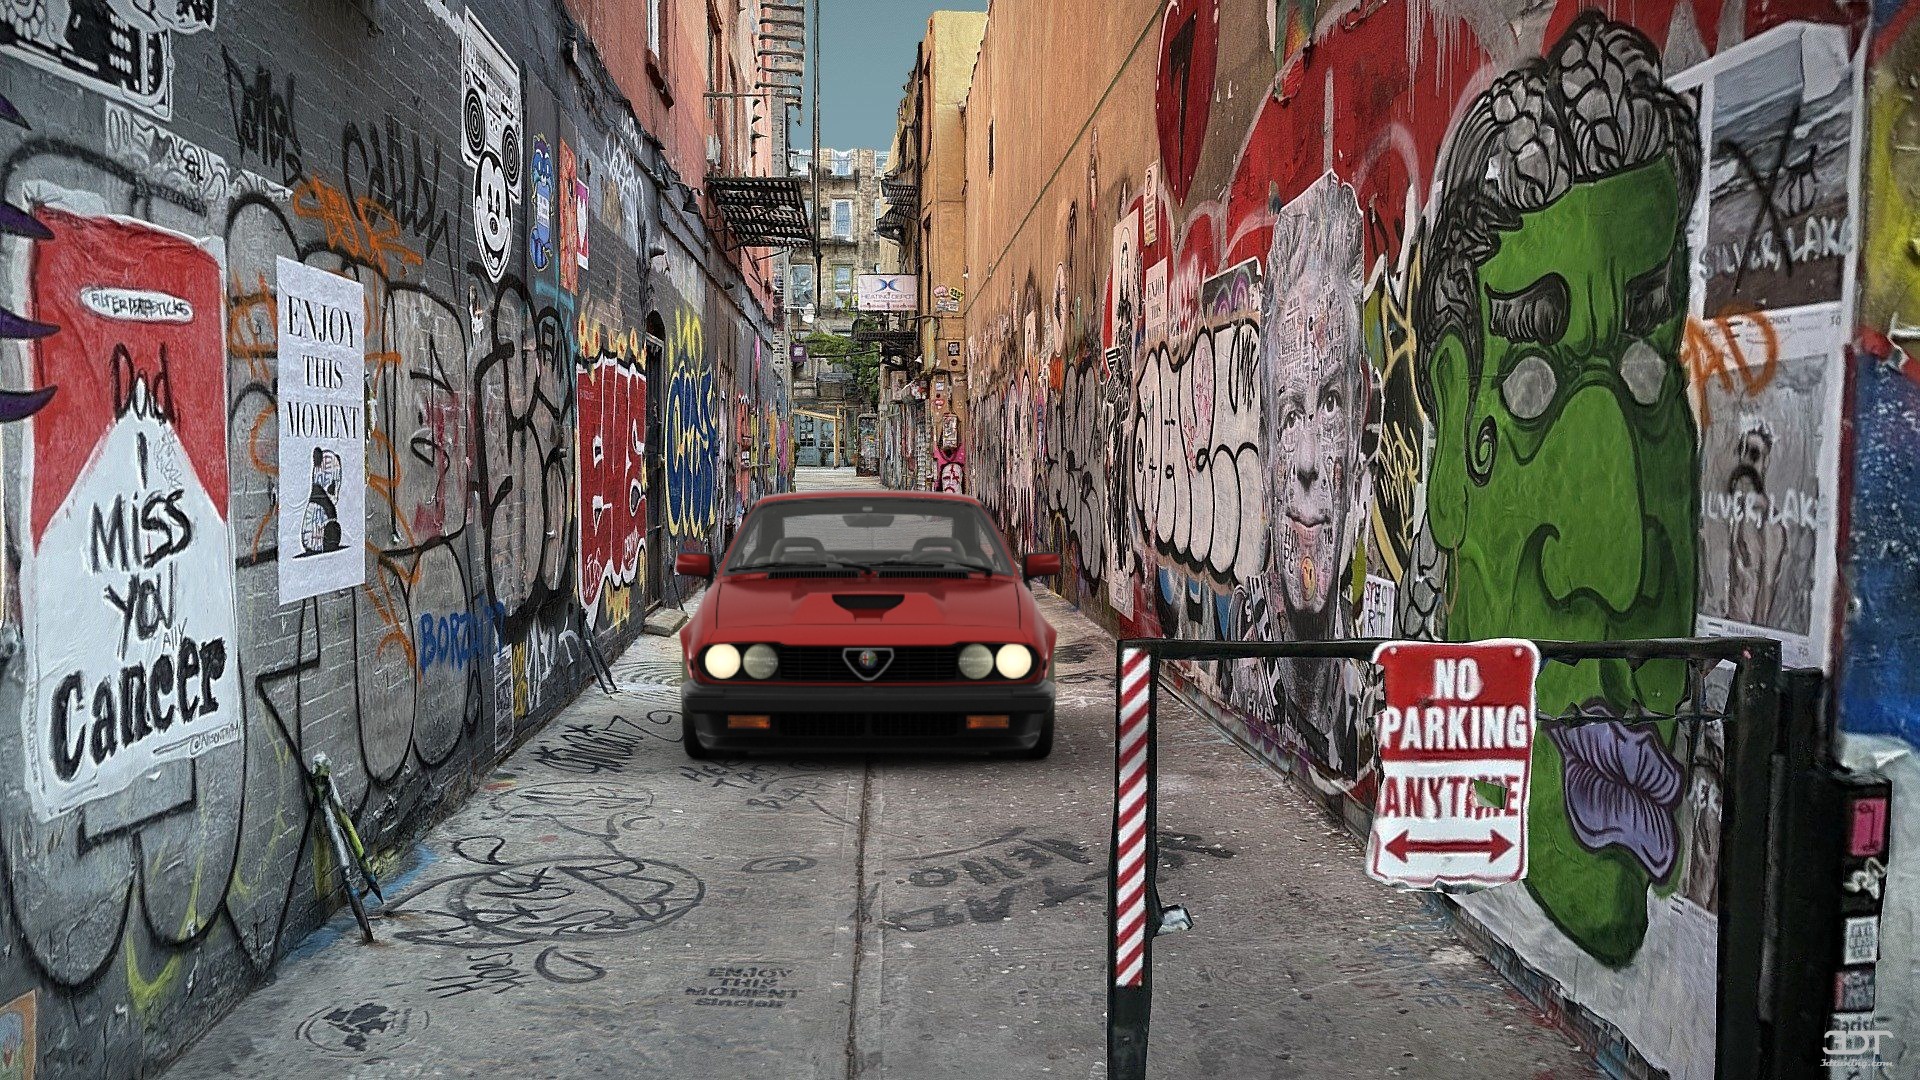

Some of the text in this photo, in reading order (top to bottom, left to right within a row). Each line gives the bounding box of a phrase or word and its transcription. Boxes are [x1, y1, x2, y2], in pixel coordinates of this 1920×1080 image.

[286, 296, 357, 350] ENJOY
[302, 353, 344, 390] THIS
[286, 401, 361, 440] MOMENT
[1433, 657, 1484, 701] NO
[51, 636, 227, 784] Cancer
[1379, 705, 1528, 751] PARKING
